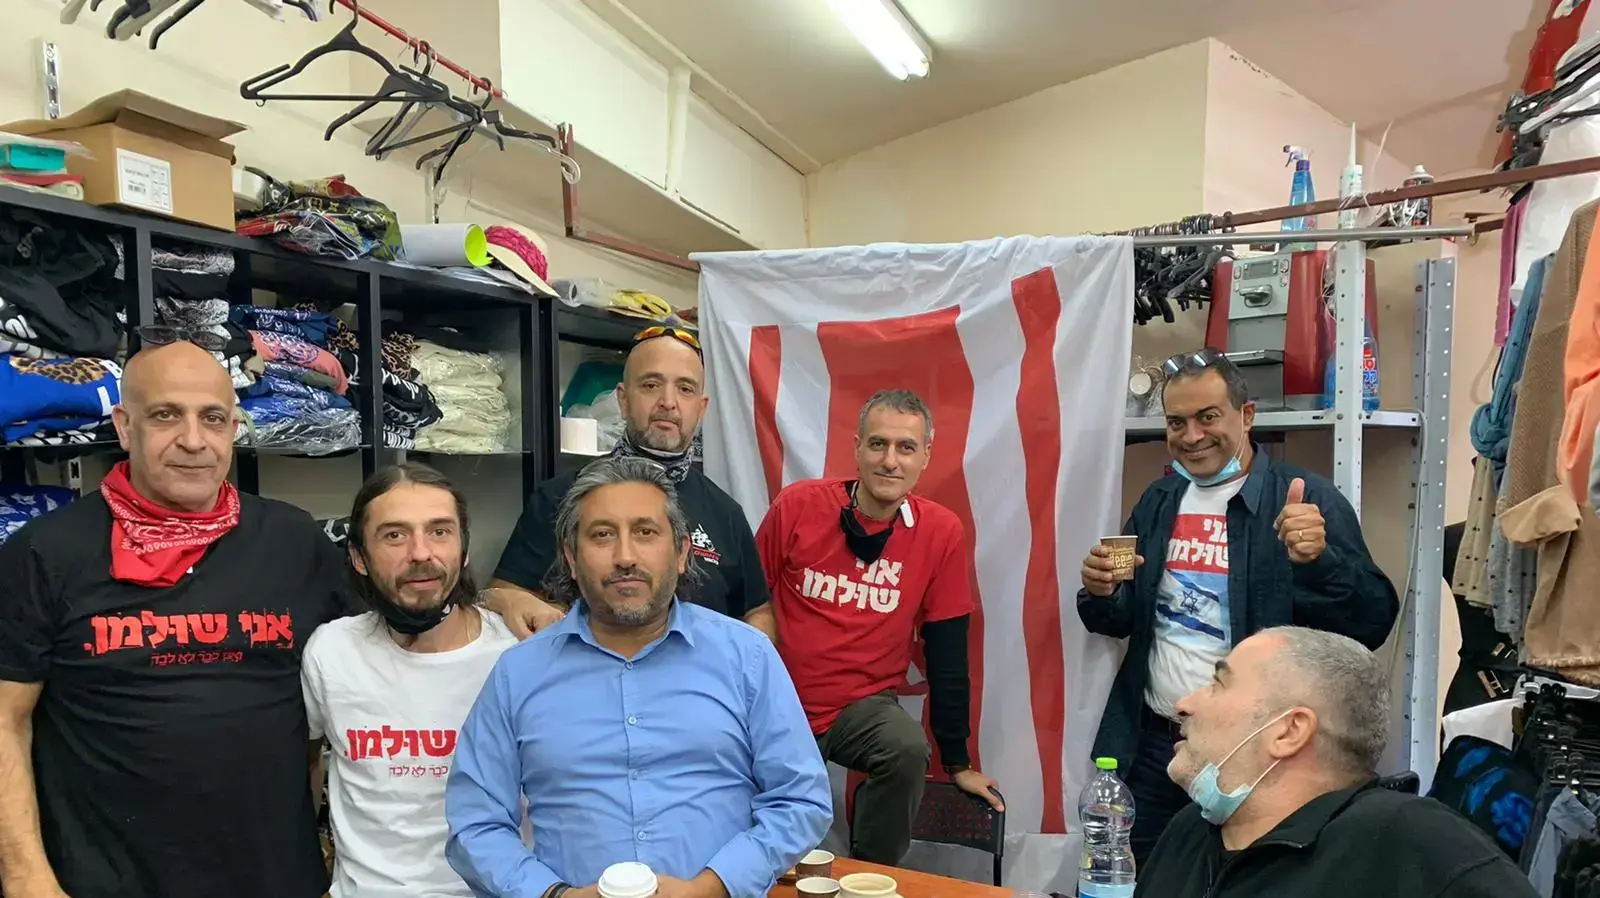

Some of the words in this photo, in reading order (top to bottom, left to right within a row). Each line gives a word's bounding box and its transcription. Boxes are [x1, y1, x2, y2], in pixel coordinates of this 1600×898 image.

[855, 557, 902, 587] אני
[238, 609, 294, 648] אני
[151, 652, 176, 667] לבד
[178, 652, 196, 665] לא
[198, 651, 221, 664] כבר
[389, 765, 410, 778] לבד
[411, 765, 426, 778] לא
[429, 765, 449, 777] כבר
